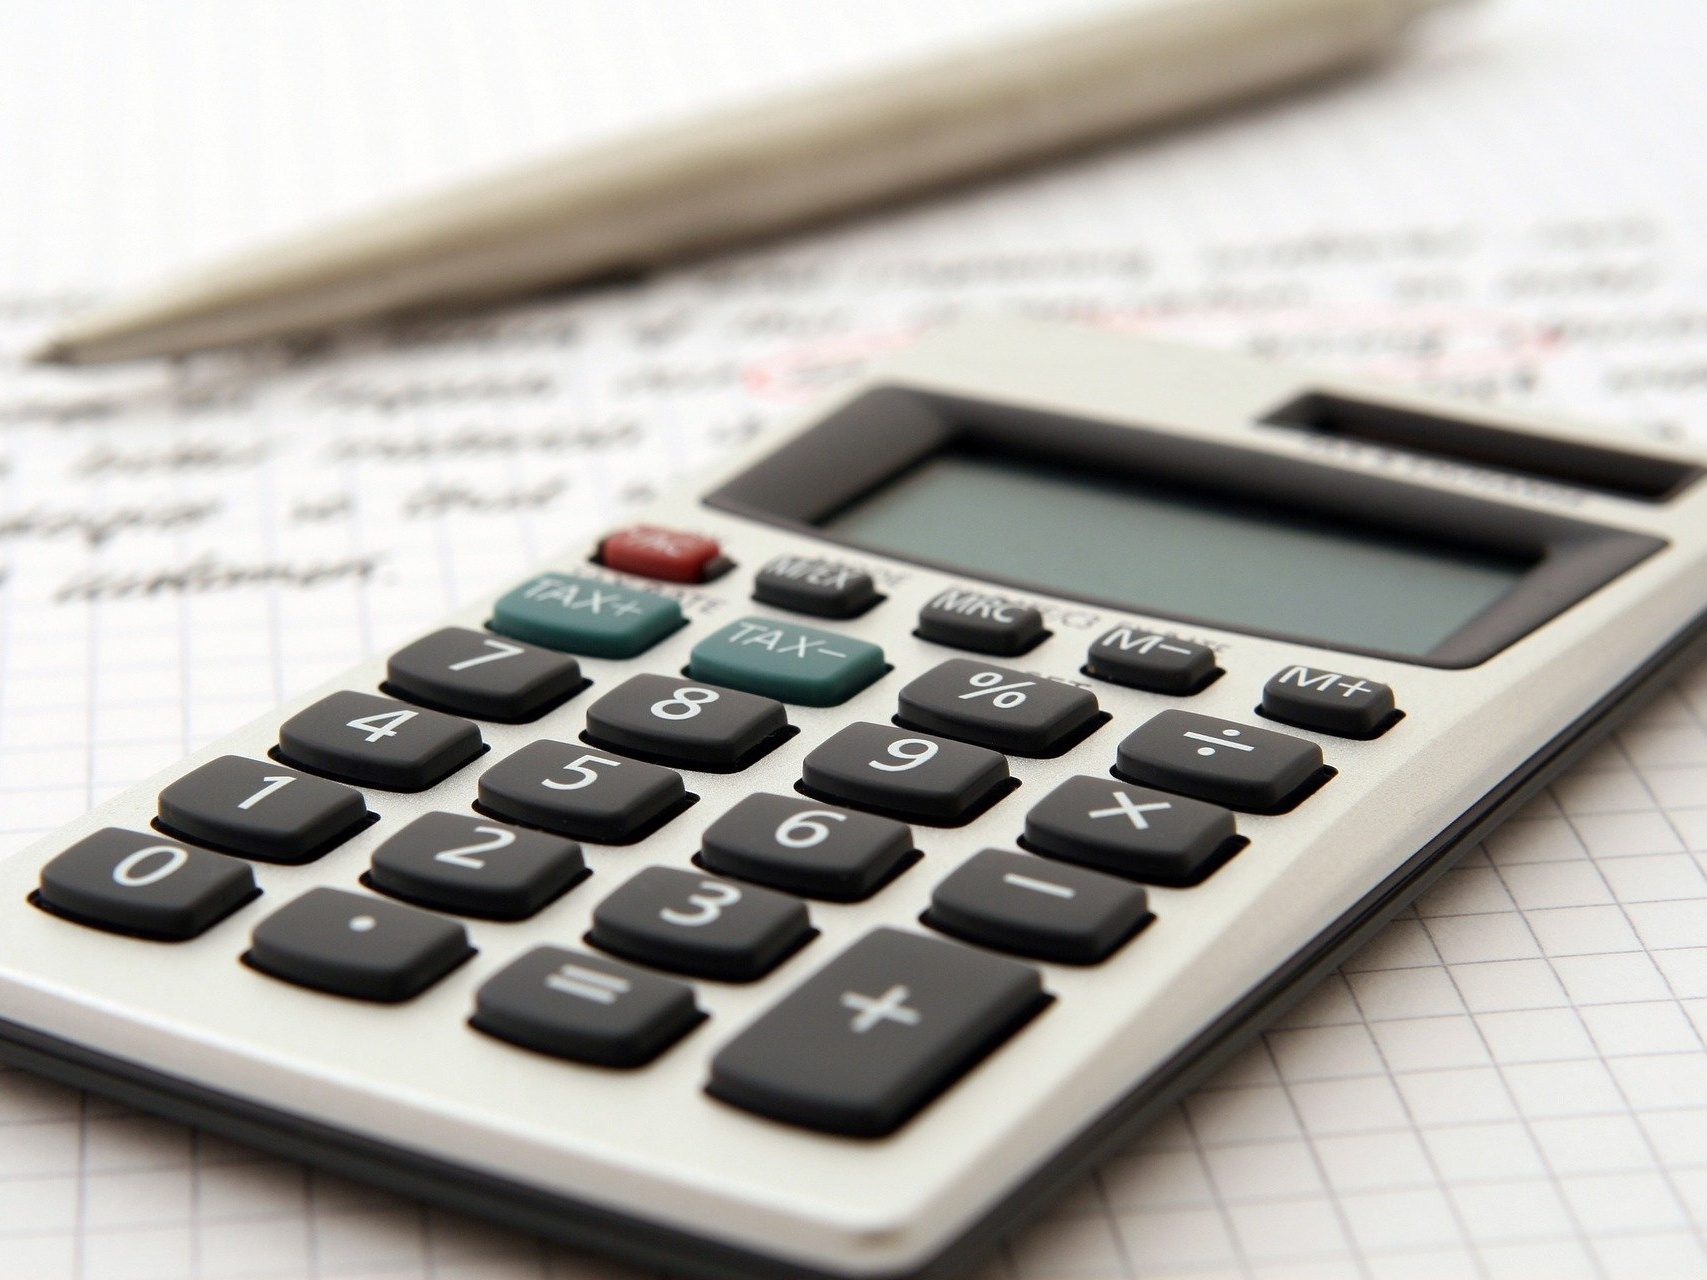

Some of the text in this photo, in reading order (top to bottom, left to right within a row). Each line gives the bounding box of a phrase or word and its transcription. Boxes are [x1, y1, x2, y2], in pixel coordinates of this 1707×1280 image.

[523, 577, 644, 616] TAX+
[932, 589, 1015, 624] MRC
[448, 639, 525, 672] 7
[728, 621, 847, 659] TAX-
[1102, 628, 1191, 655] M-
[957, 671, 1037, 709] %
[1279, 666, 1372, 698] M+
[650, 687, 721, 723] 8
[346, 709, 419, 743] 4
[541, 755, 621, 791] 5
[868, 738, 940, 773] 9
[237, 775, 298, 810] 1
[434, 825, 517, 870] 2
[774, 809, 848, 849] 6
[113, 845, 189, 887] 0
[660, 881, 742, 927] 3
[545, 963, 632, 1005] =
[841, 984, 921, 1033] +
